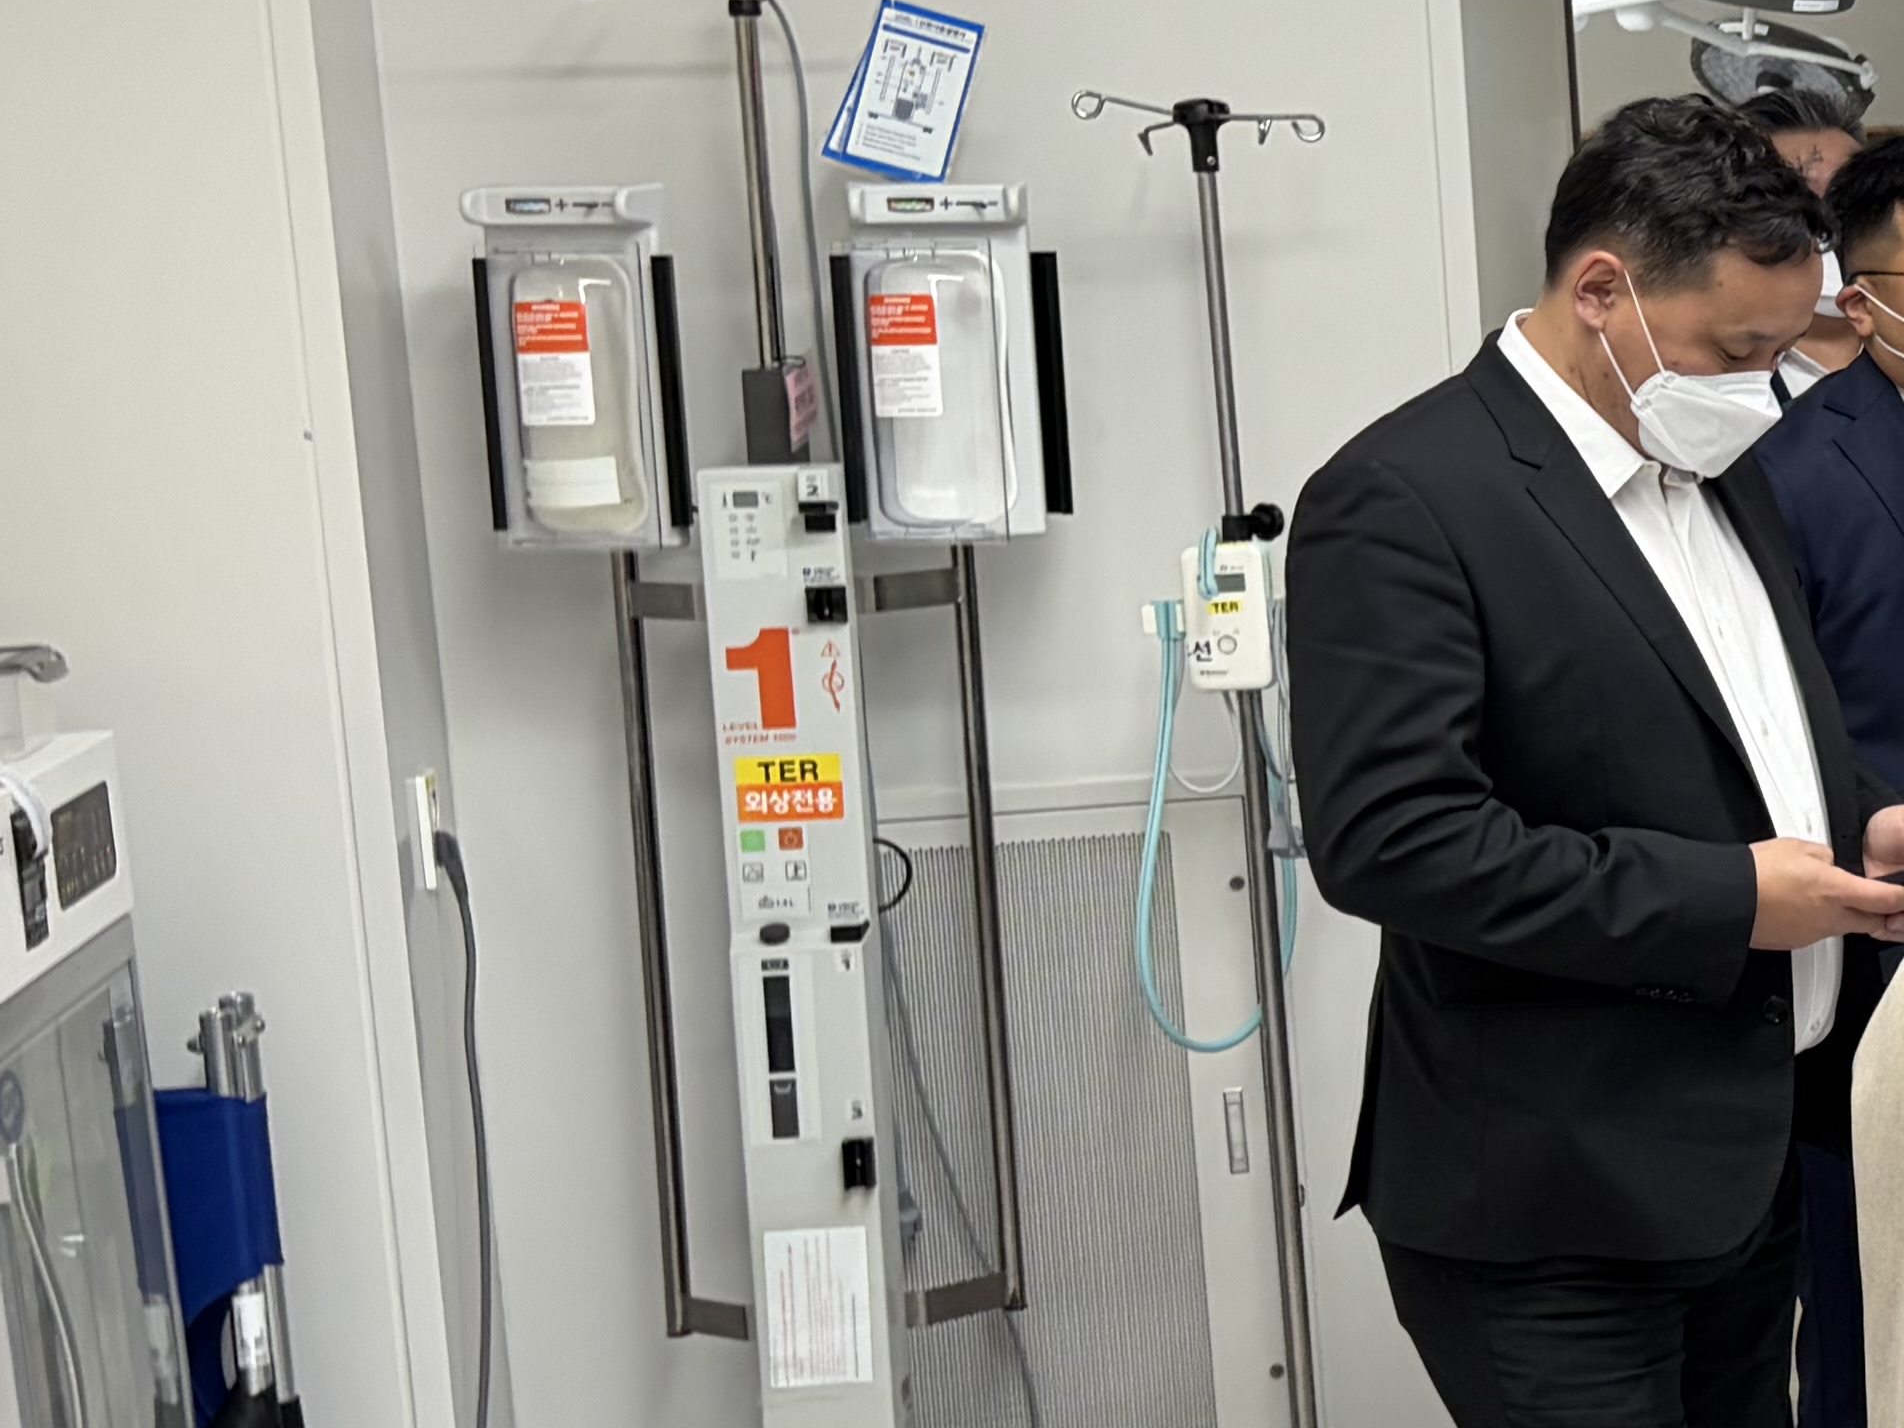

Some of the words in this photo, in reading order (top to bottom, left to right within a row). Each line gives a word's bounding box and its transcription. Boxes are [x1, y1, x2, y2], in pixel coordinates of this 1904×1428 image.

[1211, 601, 1239, 615] TER
[725, 627, 797, 730] 1
[757, 759, 819, 783] TER
[744, 787, 838, 815] 외상전용
